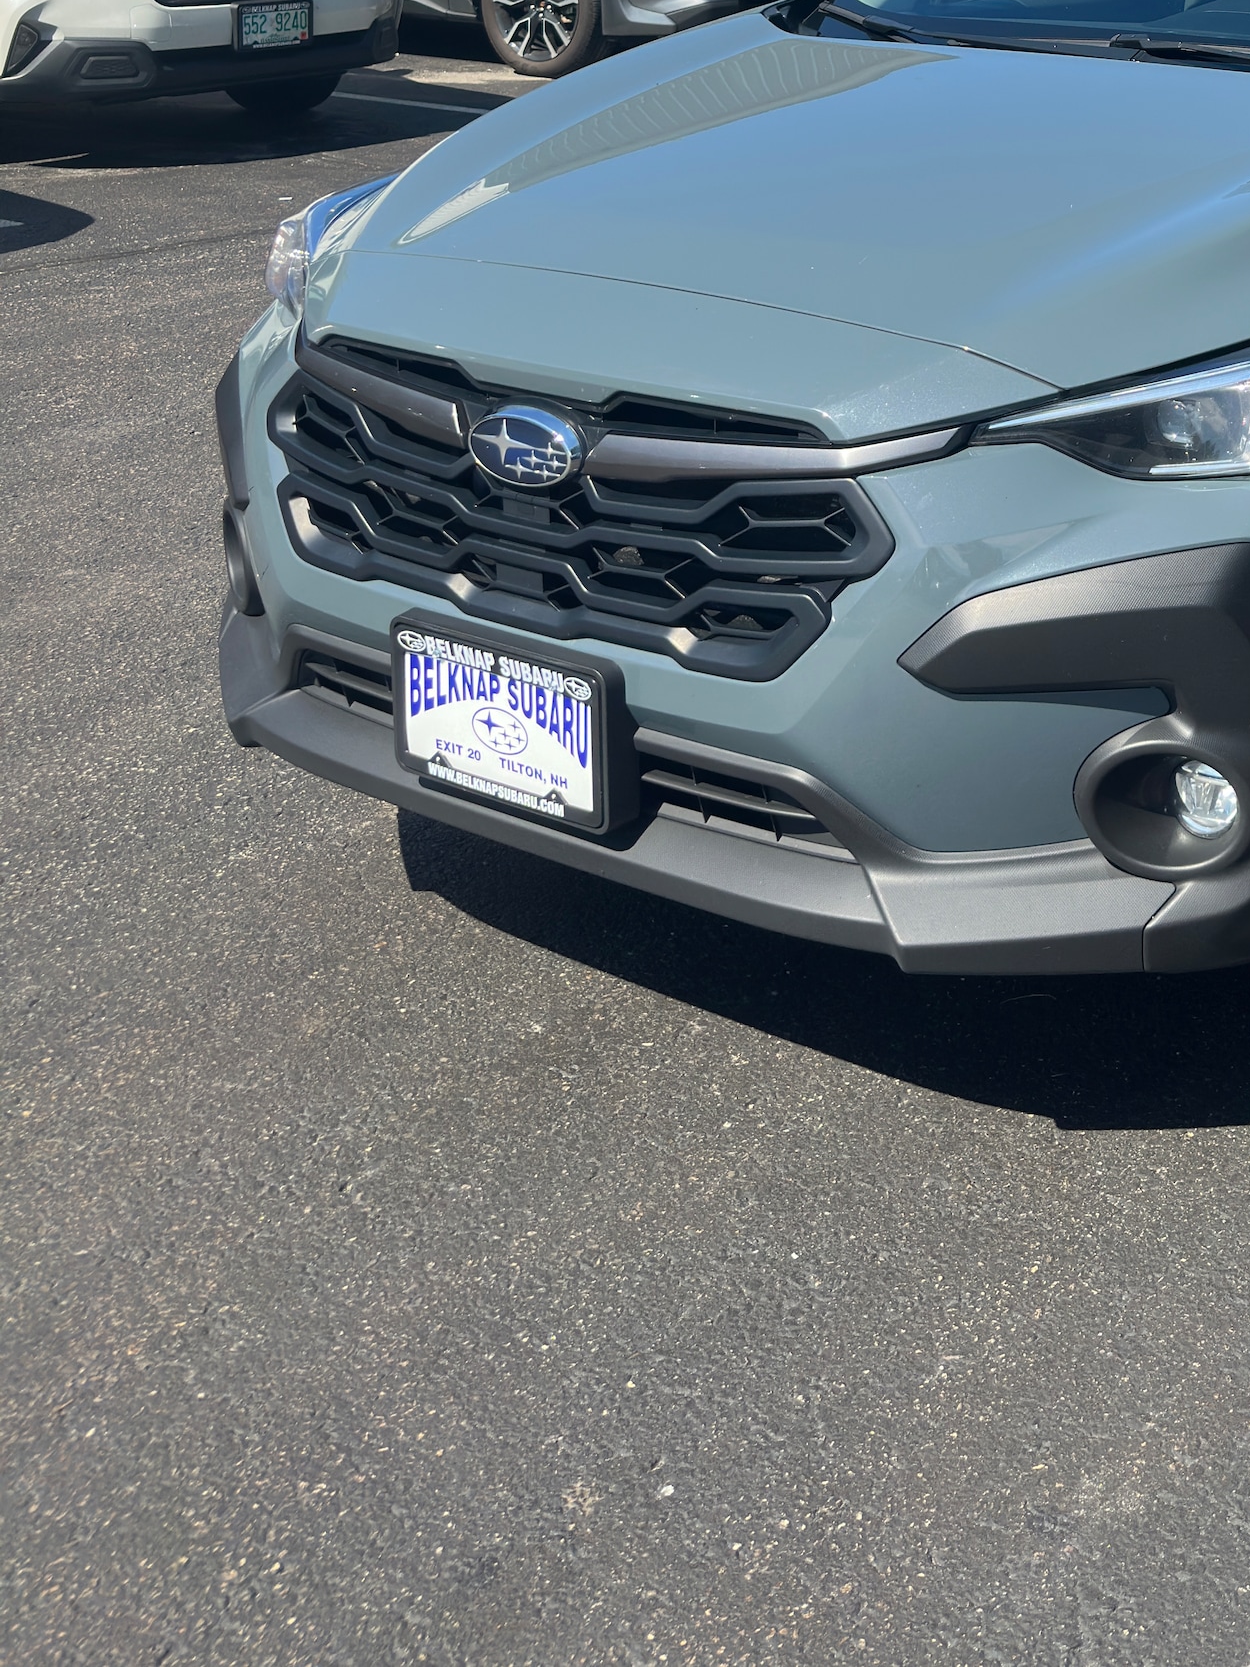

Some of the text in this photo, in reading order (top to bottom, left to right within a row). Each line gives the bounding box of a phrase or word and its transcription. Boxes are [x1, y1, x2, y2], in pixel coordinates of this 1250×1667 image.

[244, 10, 307, 35] 552 9240
[425, 636, 565, 693] BELKNAP SUBARU
[409, 653, 592, 769] BELKNAP SUBARU
[435, 738, 481, 762] EXIT 20
[499, 756, 568, 789] TILTON, NH
[427, 761, 565, 818] WWW.BELKNAPSUBARU.COM
